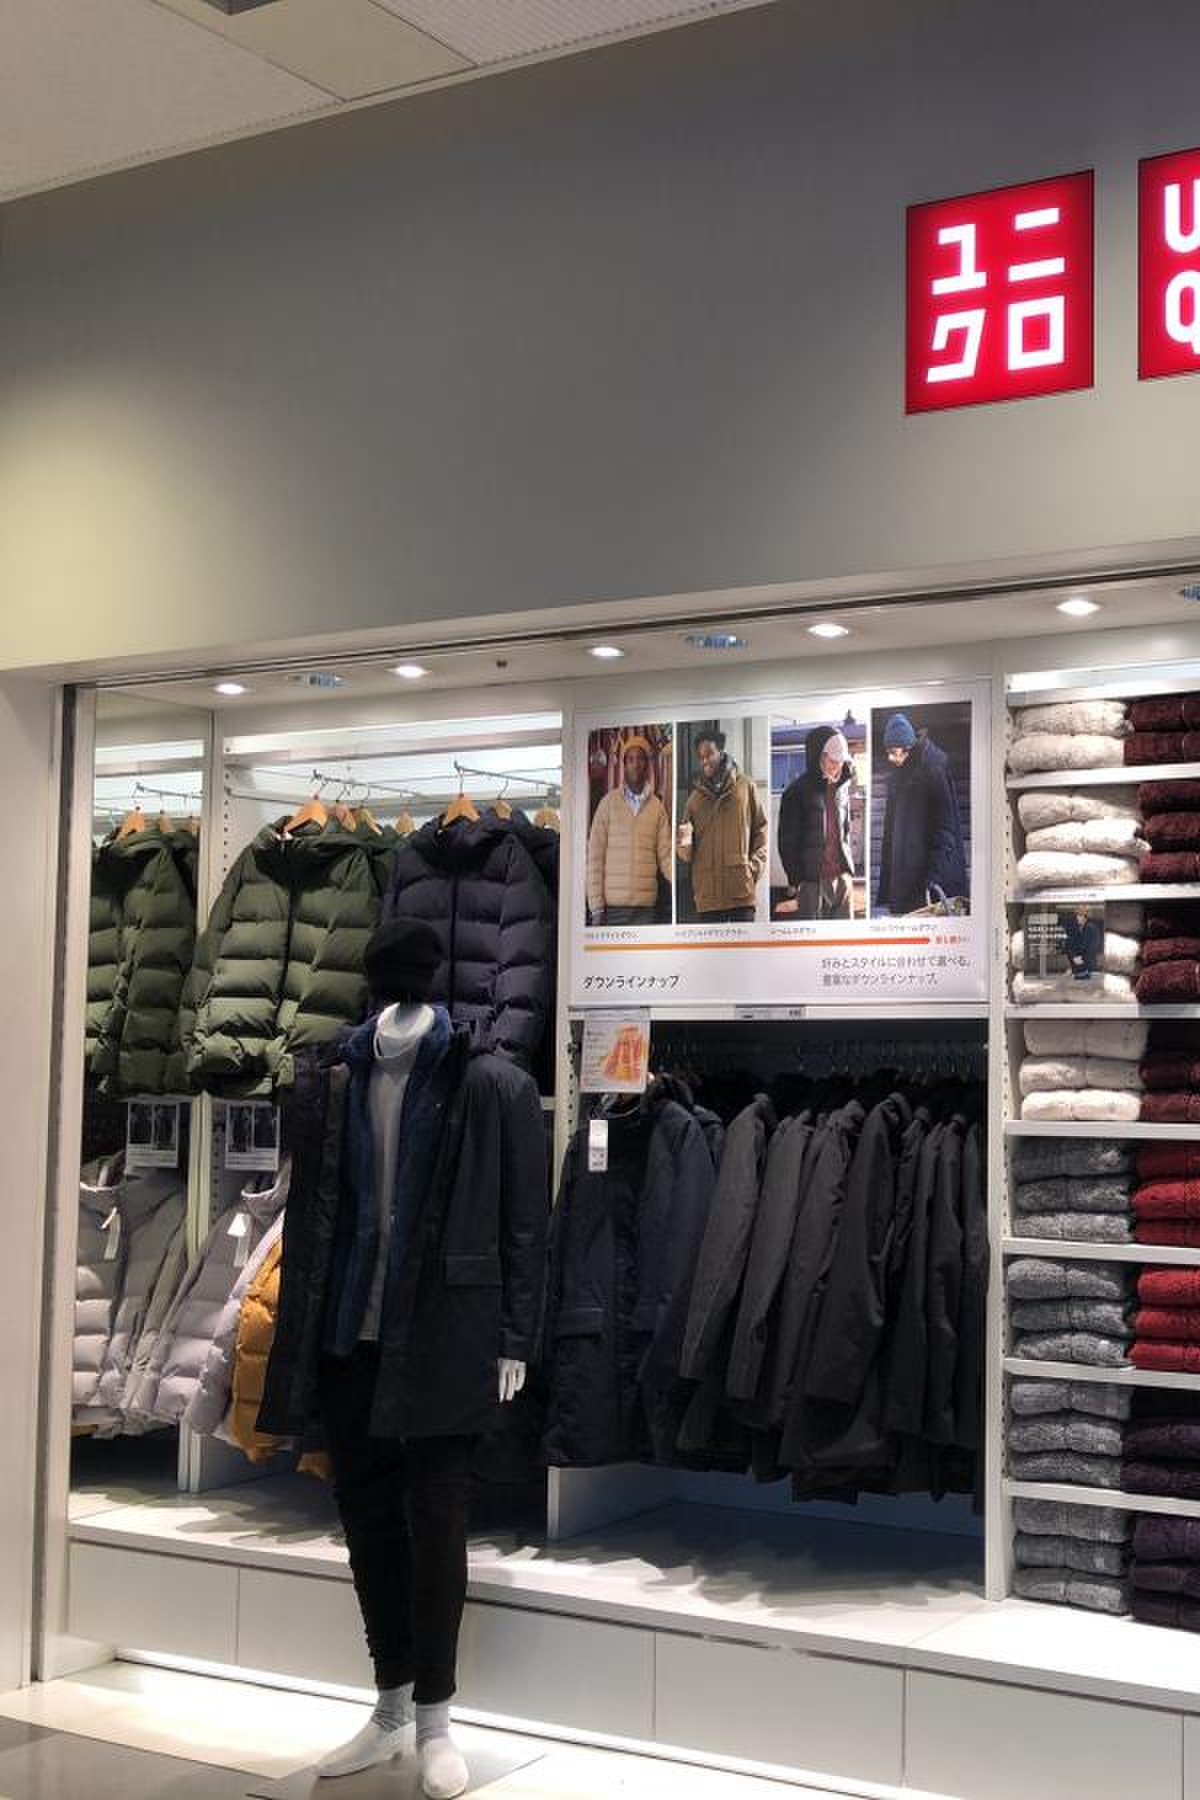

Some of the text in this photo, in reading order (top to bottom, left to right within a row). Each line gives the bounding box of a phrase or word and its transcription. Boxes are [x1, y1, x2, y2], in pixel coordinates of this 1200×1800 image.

[931, 206, 1066, 296] ユニ
[926, 295, 1066, 384] クロ
[583, 974, 681, 990] ダウンラインナップ
